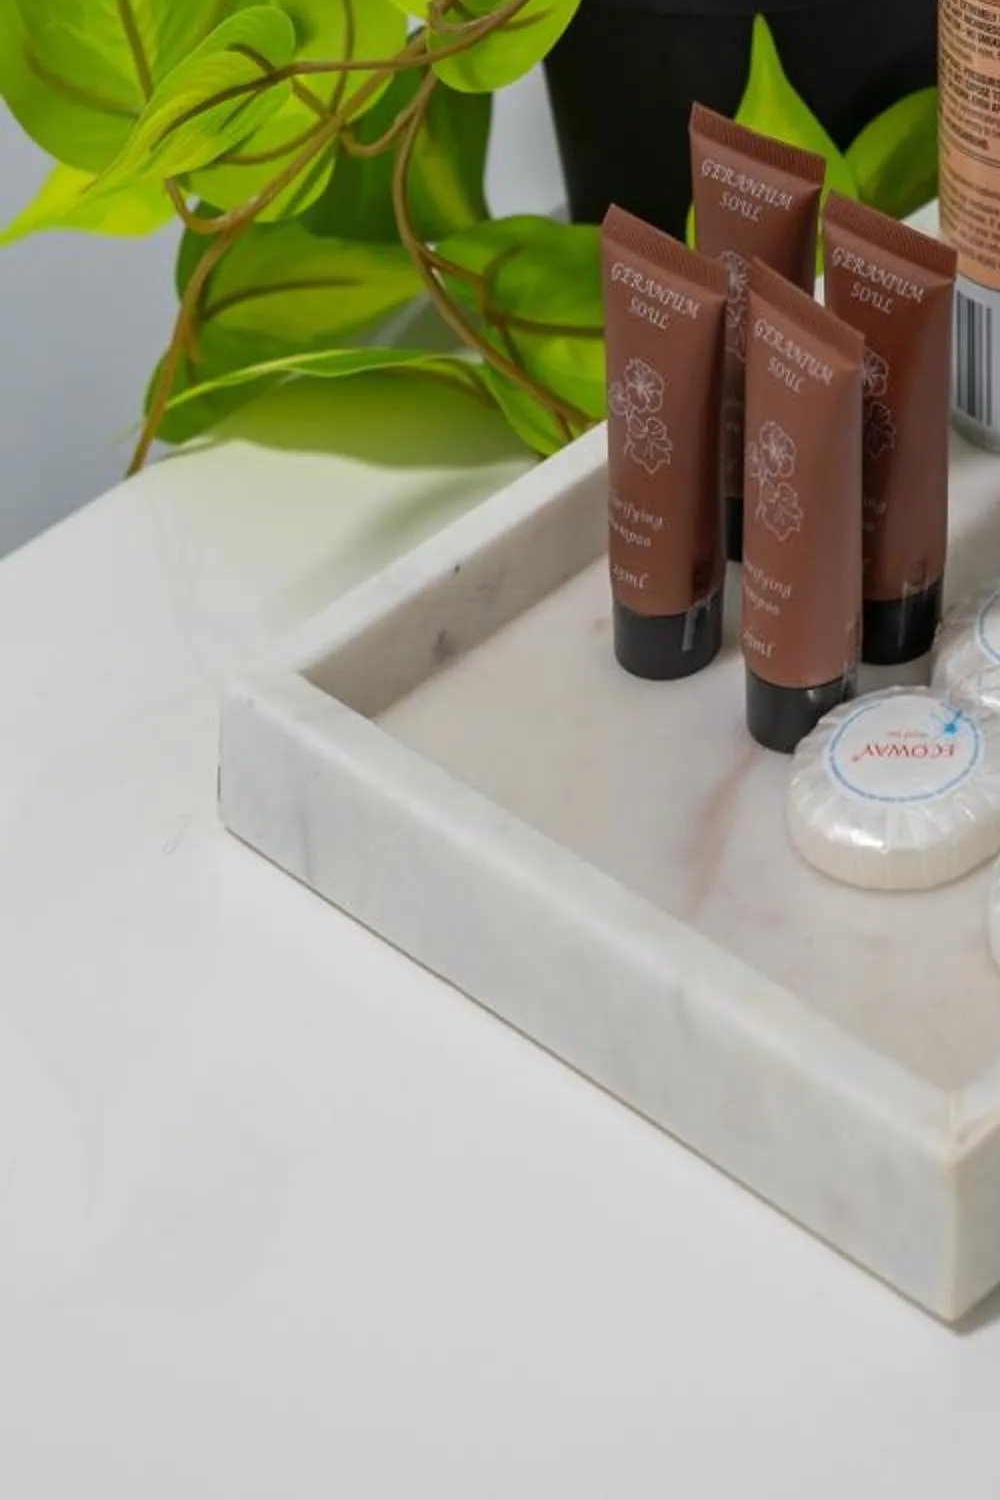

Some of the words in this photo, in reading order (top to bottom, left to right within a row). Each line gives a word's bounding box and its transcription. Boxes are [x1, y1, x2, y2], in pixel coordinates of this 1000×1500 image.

[700, 157, 793, 211] GERANIUM
[719, 190, 763, 224] SOUL
[611, 261, 703, 321] GERANIUM
[831, 245, 926, 304] GERANIUM
[628, 295, 670, 330] SOUL
[850, 281, 894, 315] SOUL
[753, 317, 835, 387] GERANIUM
[767, 355, 807, 395] SOUL
[859, 743, 956, 762] ECOWAY
